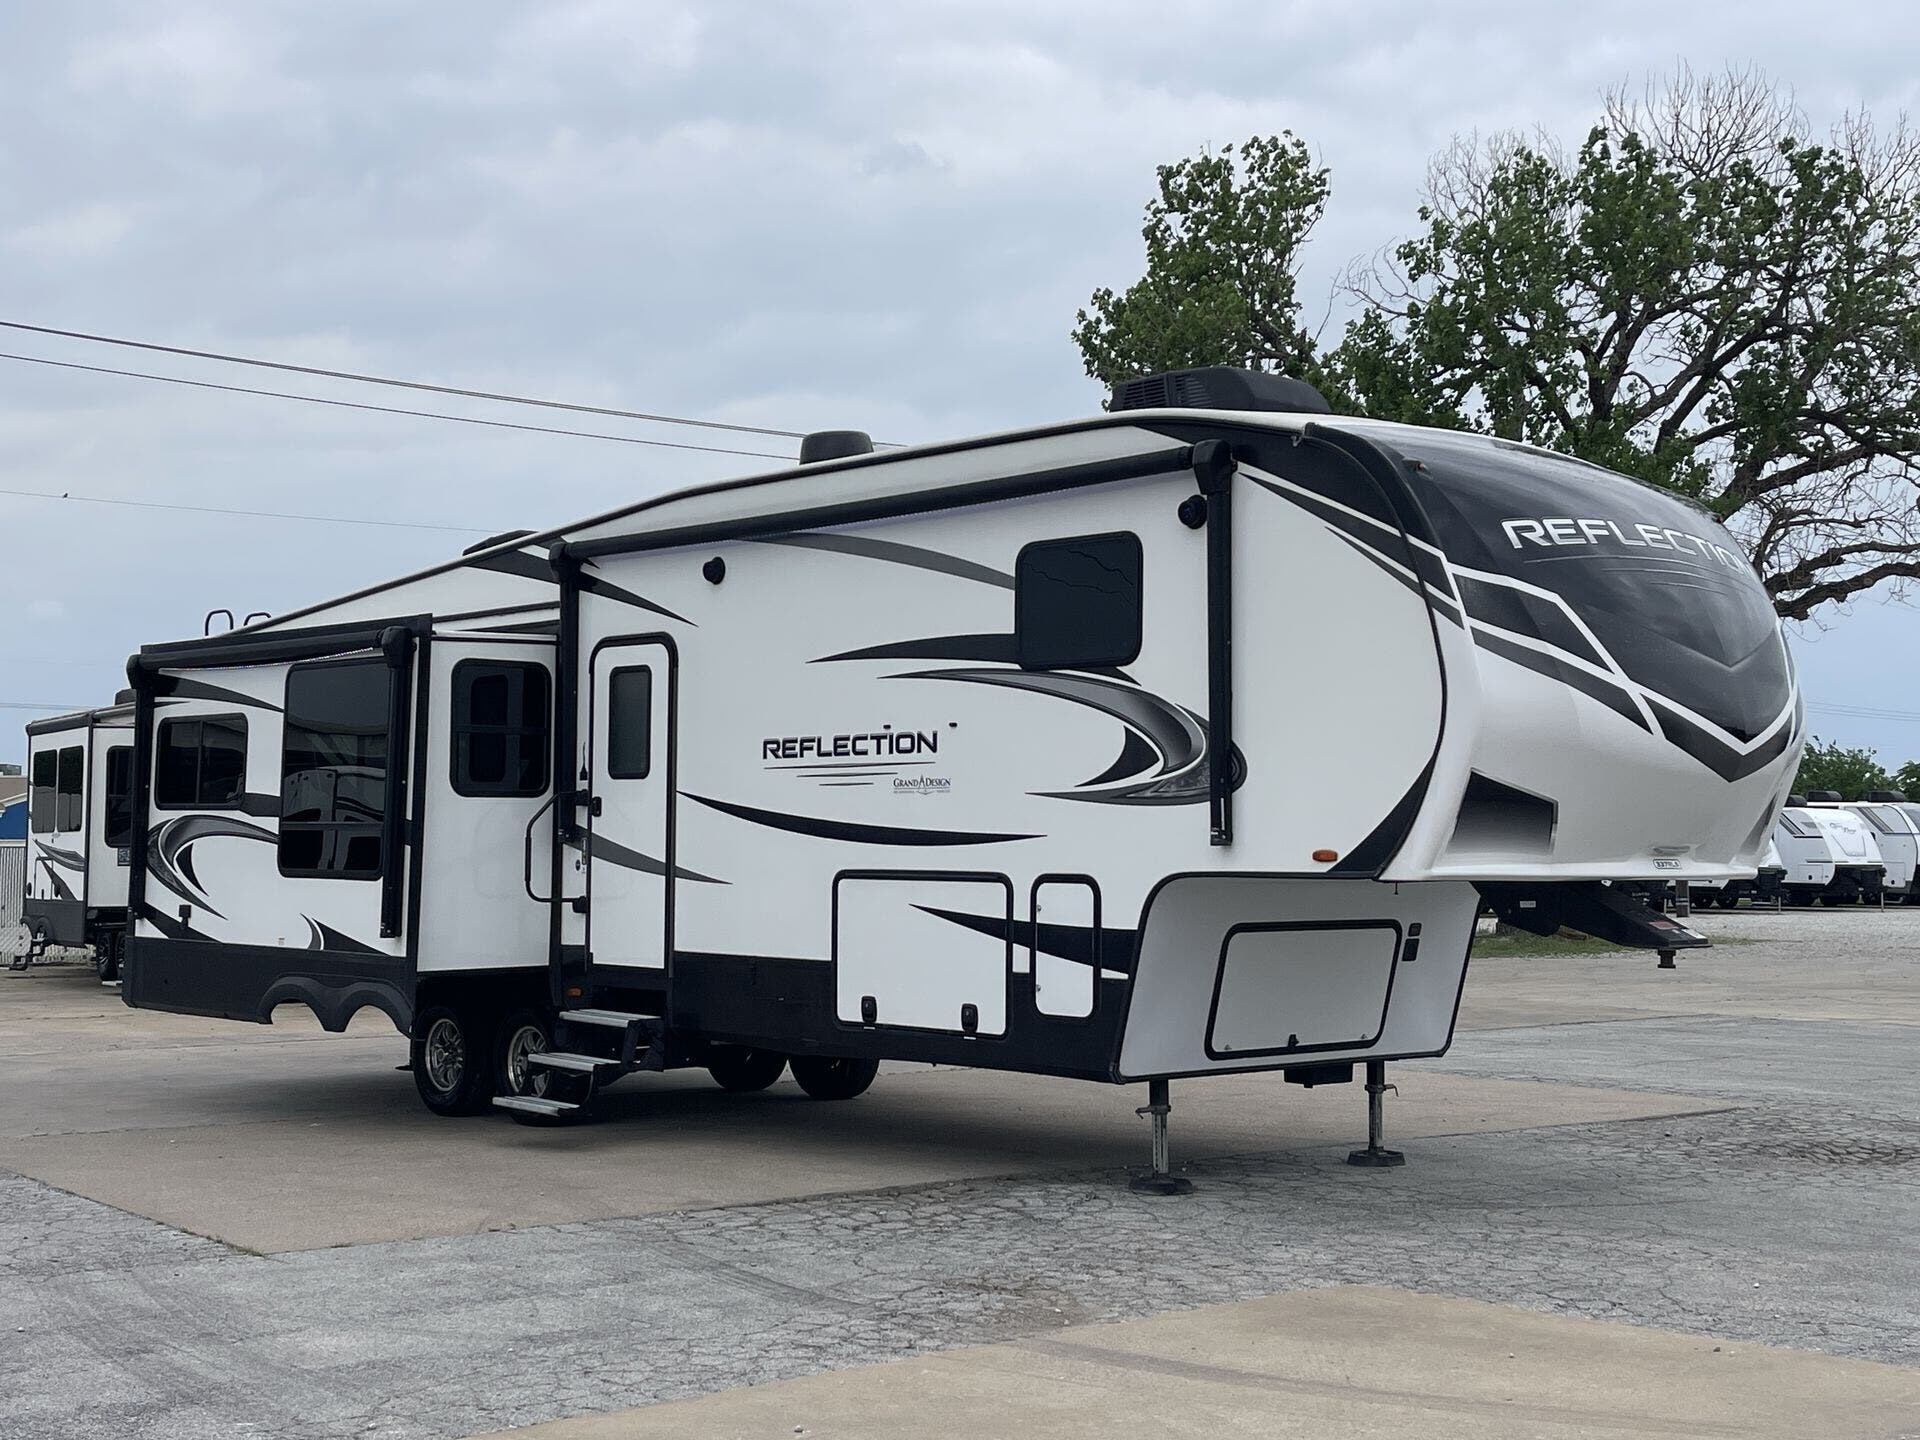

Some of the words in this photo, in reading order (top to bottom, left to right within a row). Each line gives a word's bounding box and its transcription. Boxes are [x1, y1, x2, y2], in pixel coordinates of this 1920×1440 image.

[762, 730, 938, 759] REFLECTION
[893, 777, 919, 787] GRAND
[925, 777, 951, 787] DESIGN
